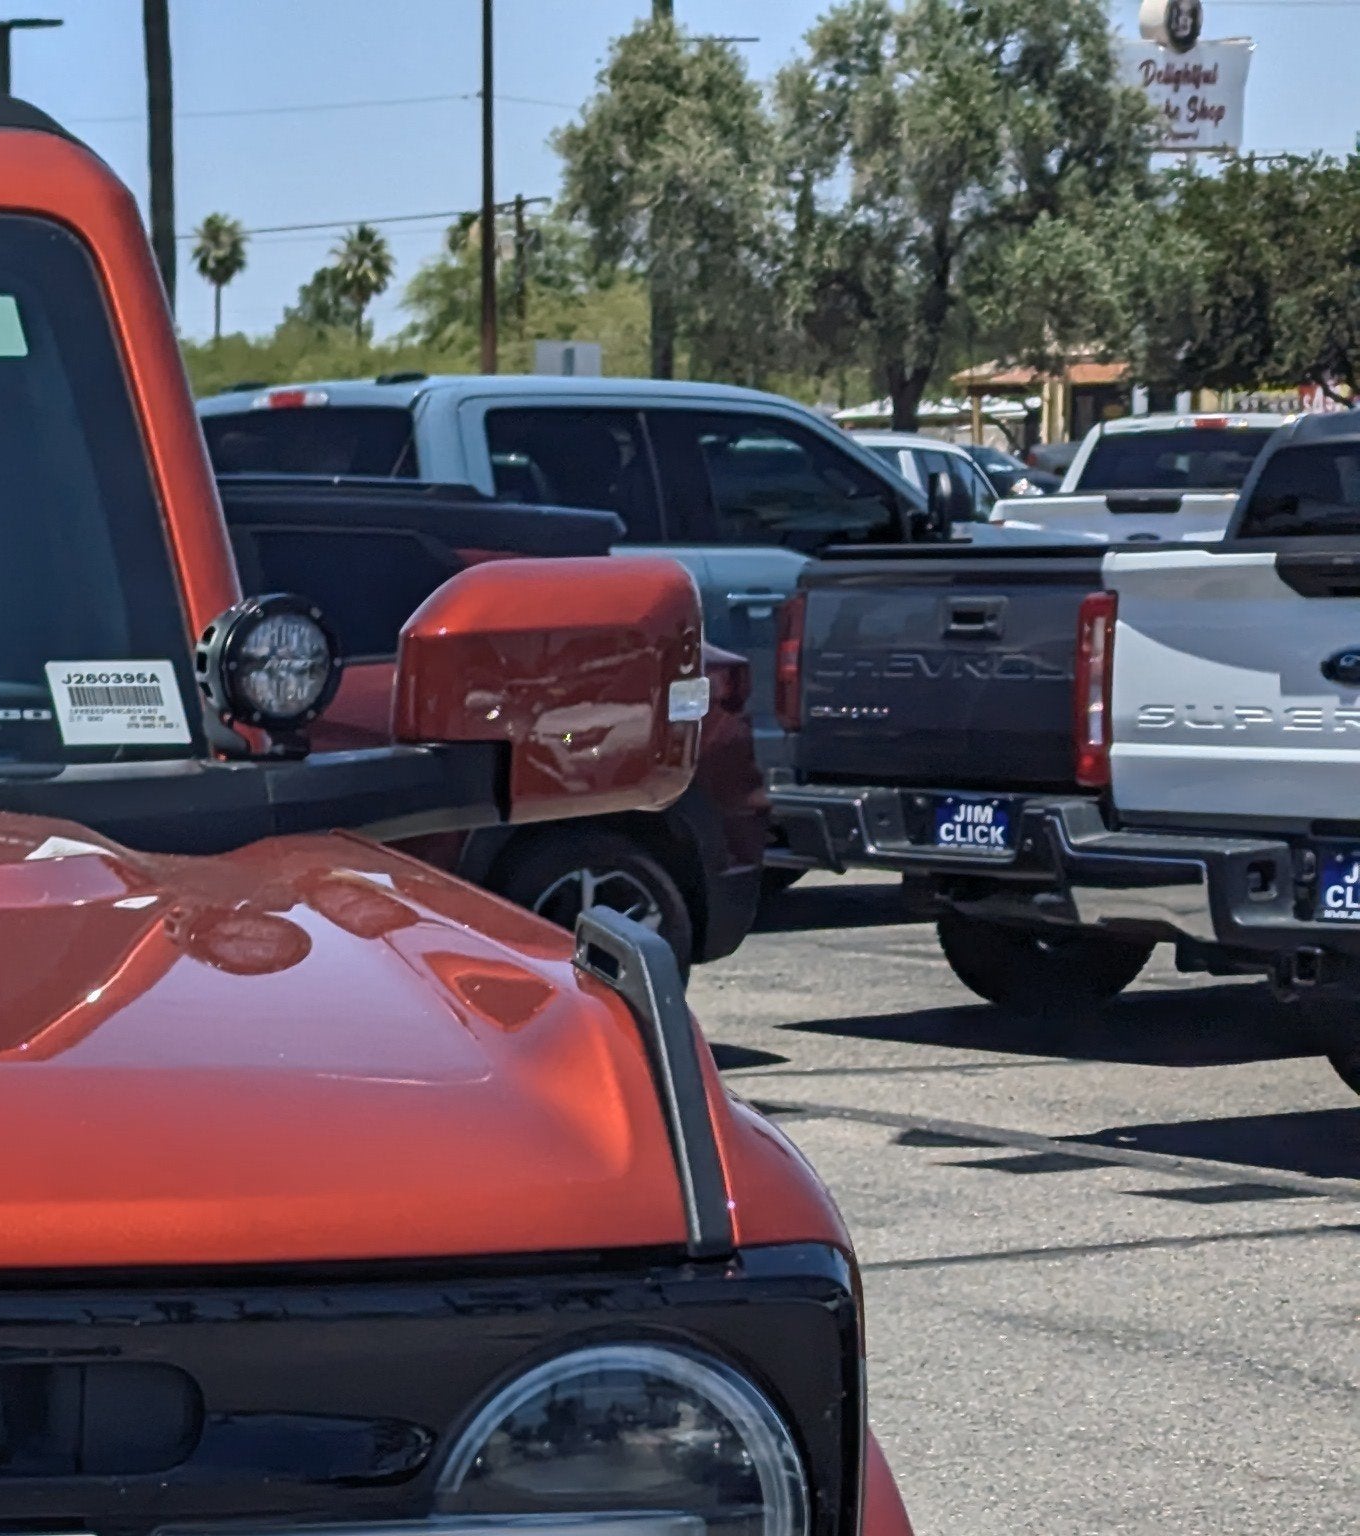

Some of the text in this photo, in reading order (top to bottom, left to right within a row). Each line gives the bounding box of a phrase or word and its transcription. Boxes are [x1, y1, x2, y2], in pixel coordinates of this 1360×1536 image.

[1138, 59, 1219, 92] Delightful
[1186, 95, 1226, 128] Shop
[814, 650, 1076, 680] CHEVROL
[954, 803, 994, 824] JIM
[939, 822, 1005, 845] CLICK
